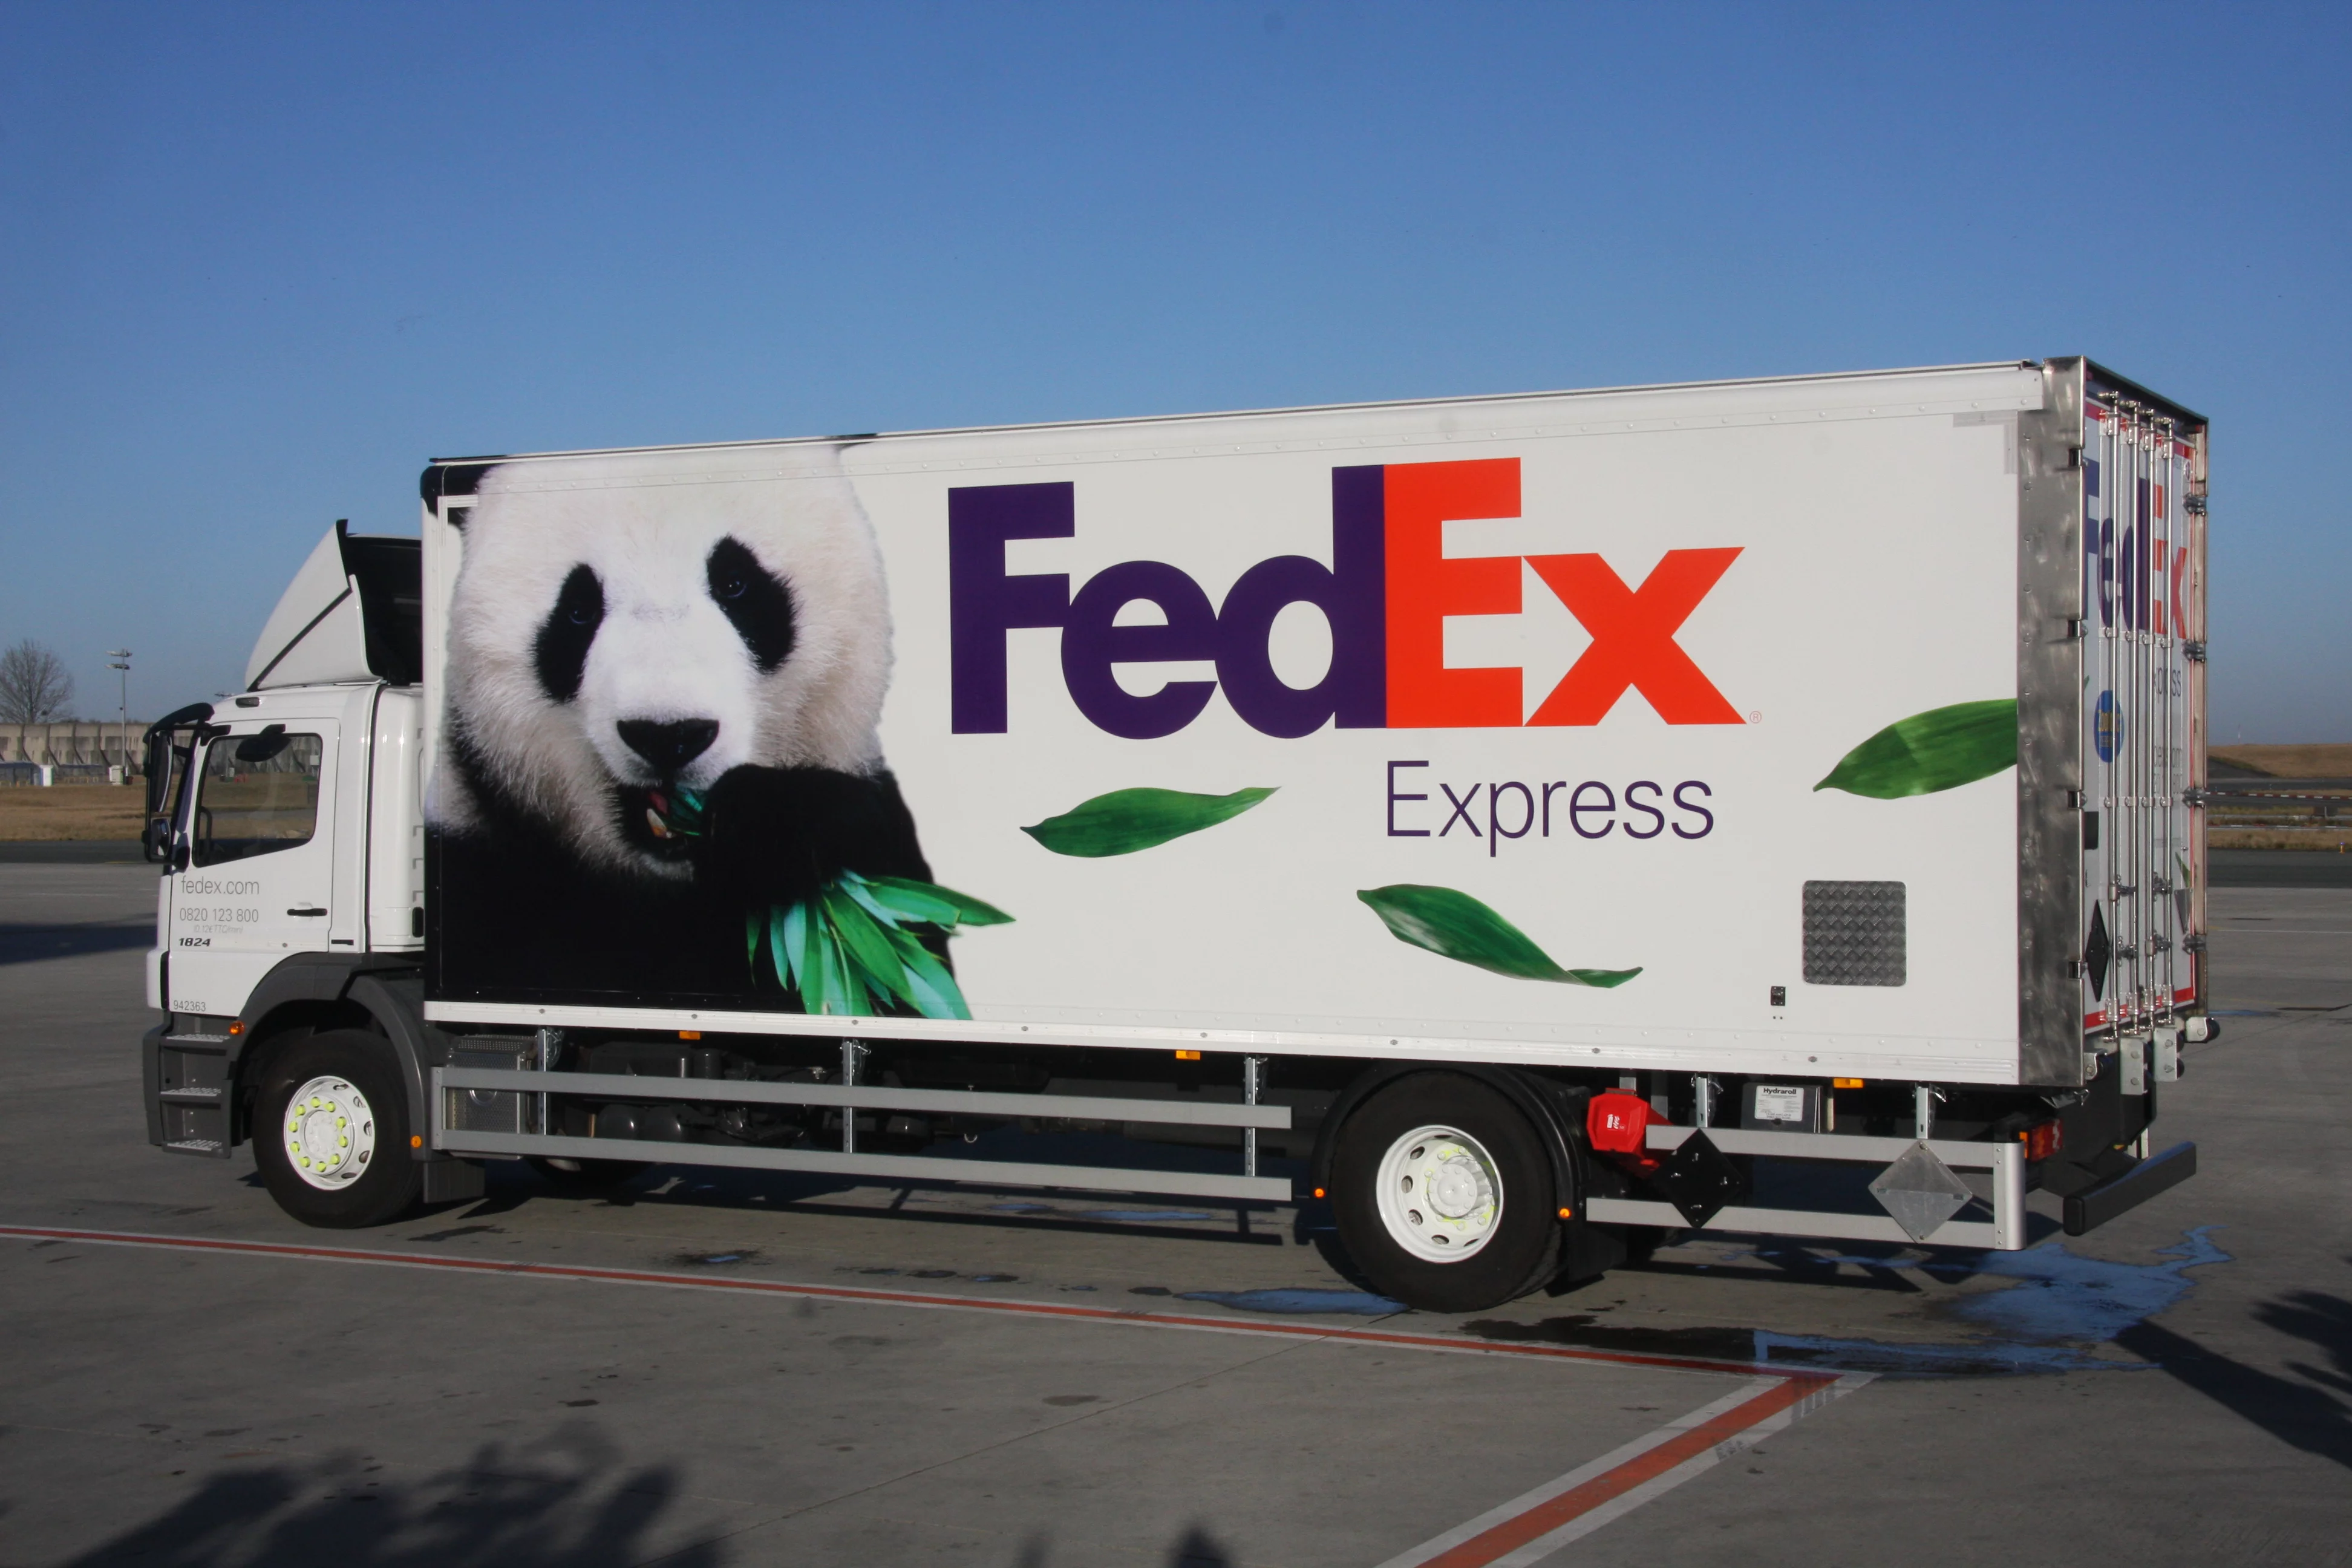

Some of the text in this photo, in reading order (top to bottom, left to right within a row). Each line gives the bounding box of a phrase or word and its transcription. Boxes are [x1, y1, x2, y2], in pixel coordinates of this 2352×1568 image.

[948, 457, 1747, 740] FedEx
[1387, 760, 1714, 857] Express
[181, 875, 260, 895] fedex.com
[180, 907, 259, 923] 0820 123 800
[178, 938, 211, 947] 1824
[173, 1000, 206, 1011] 942363
